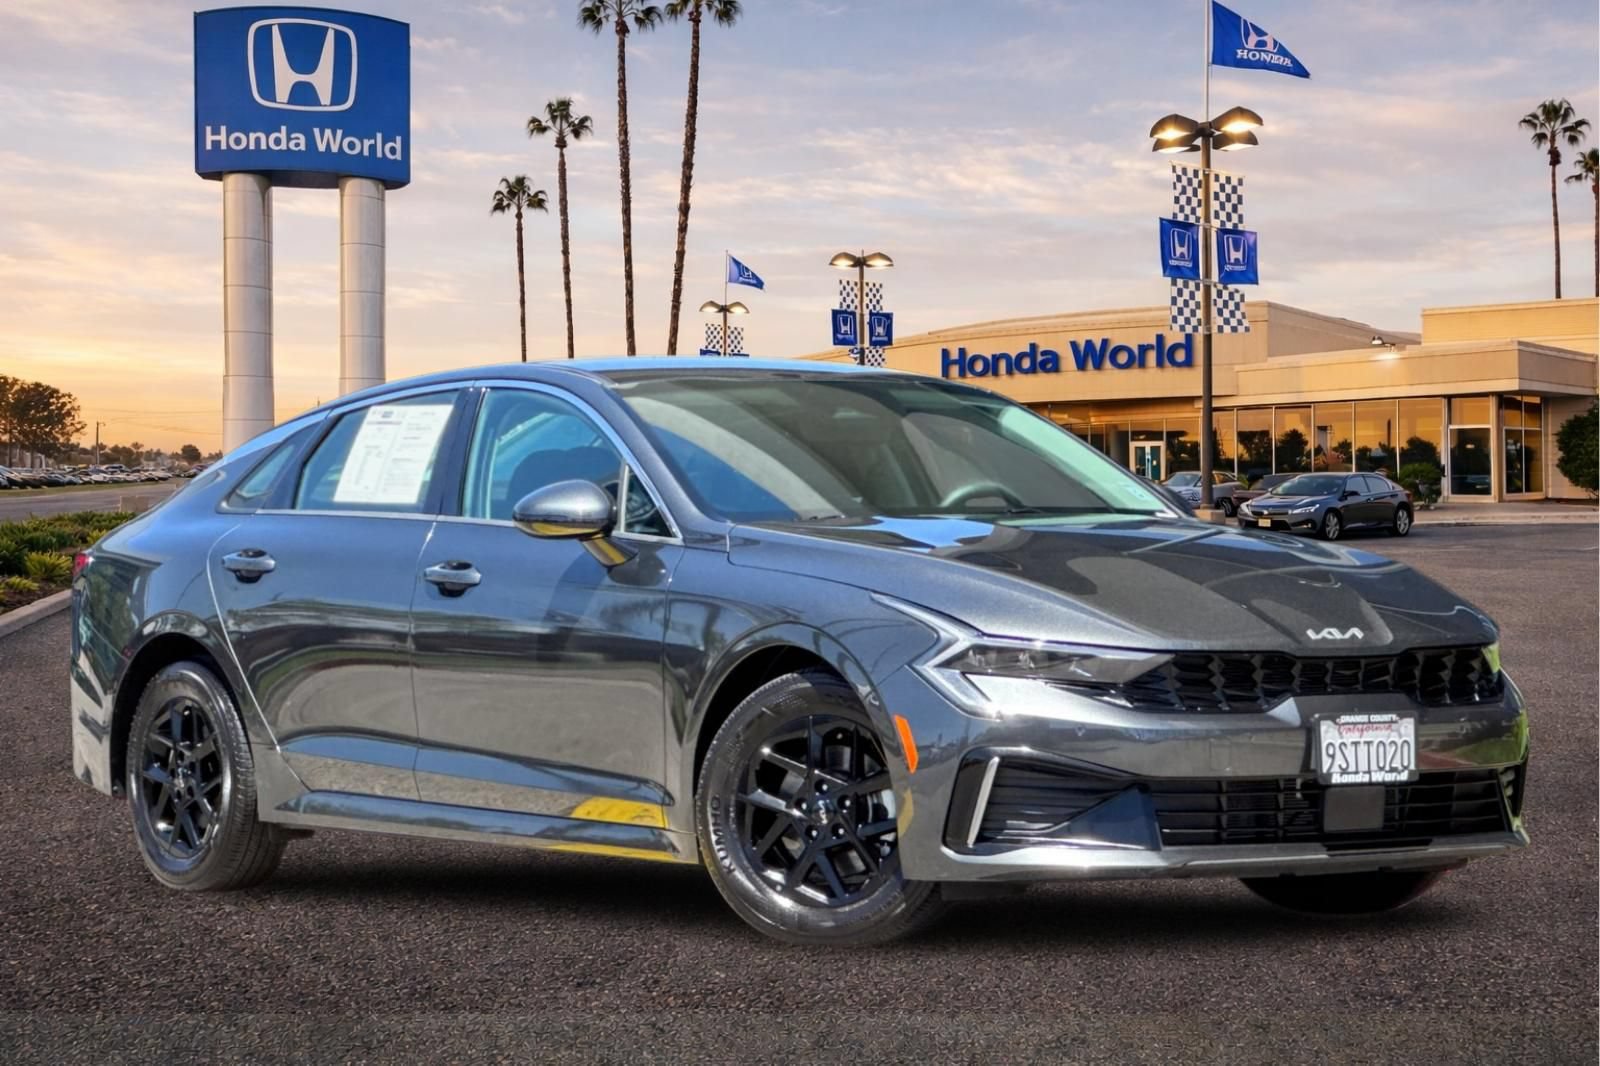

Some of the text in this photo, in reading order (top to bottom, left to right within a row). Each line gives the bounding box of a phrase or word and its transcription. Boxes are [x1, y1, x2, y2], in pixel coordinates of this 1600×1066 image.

[1236, 49, 1293, 67] HONDA
[205, 125, 402, 161] Honda World
[941, 333, 1194, 378] Honda World
[1326, 740, 1411, 773] 9STT020
[1331, 770, 1409, 784] Honda World
